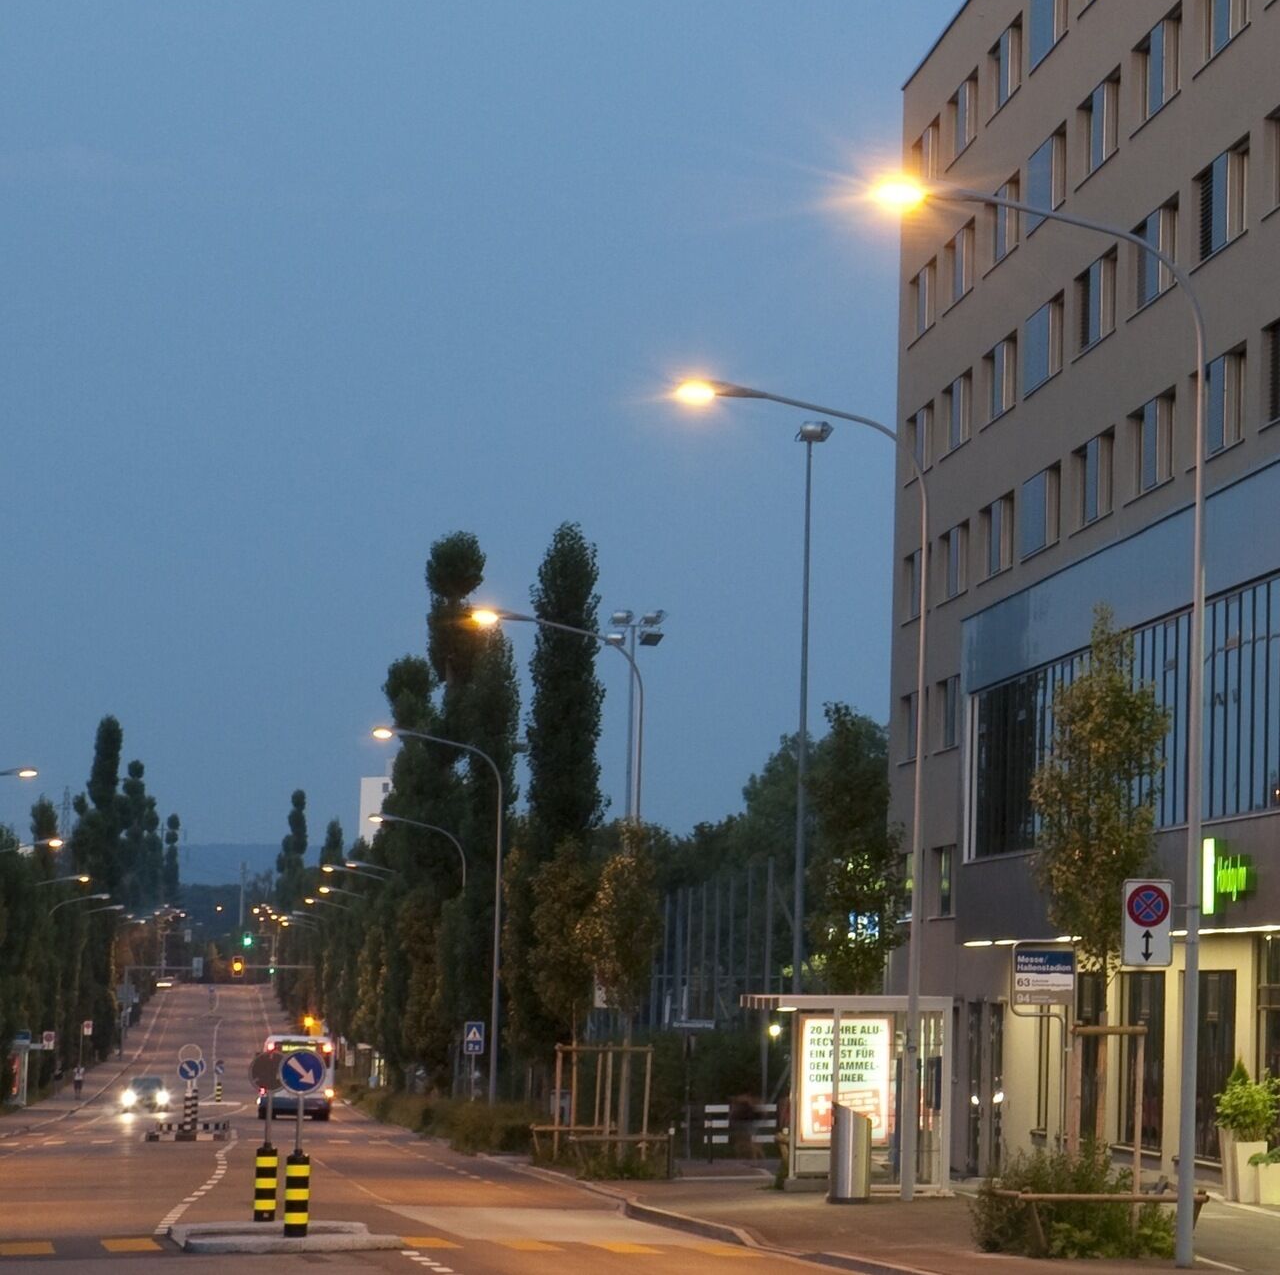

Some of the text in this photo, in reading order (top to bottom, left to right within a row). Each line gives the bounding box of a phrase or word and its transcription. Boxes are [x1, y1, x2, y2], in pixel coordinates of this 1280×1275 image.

[1016, 977, 1031, 987] 63
[810, 1025, 823, 1035] 20
[860, 1025, 884, 1035] ALU-
[809, 1037, 868, 1047] RECYLING:
[809, 1046, 875, 1059] EIN FST FÜR
[809, 1061, 880, 1071] DEN AMMEL-
